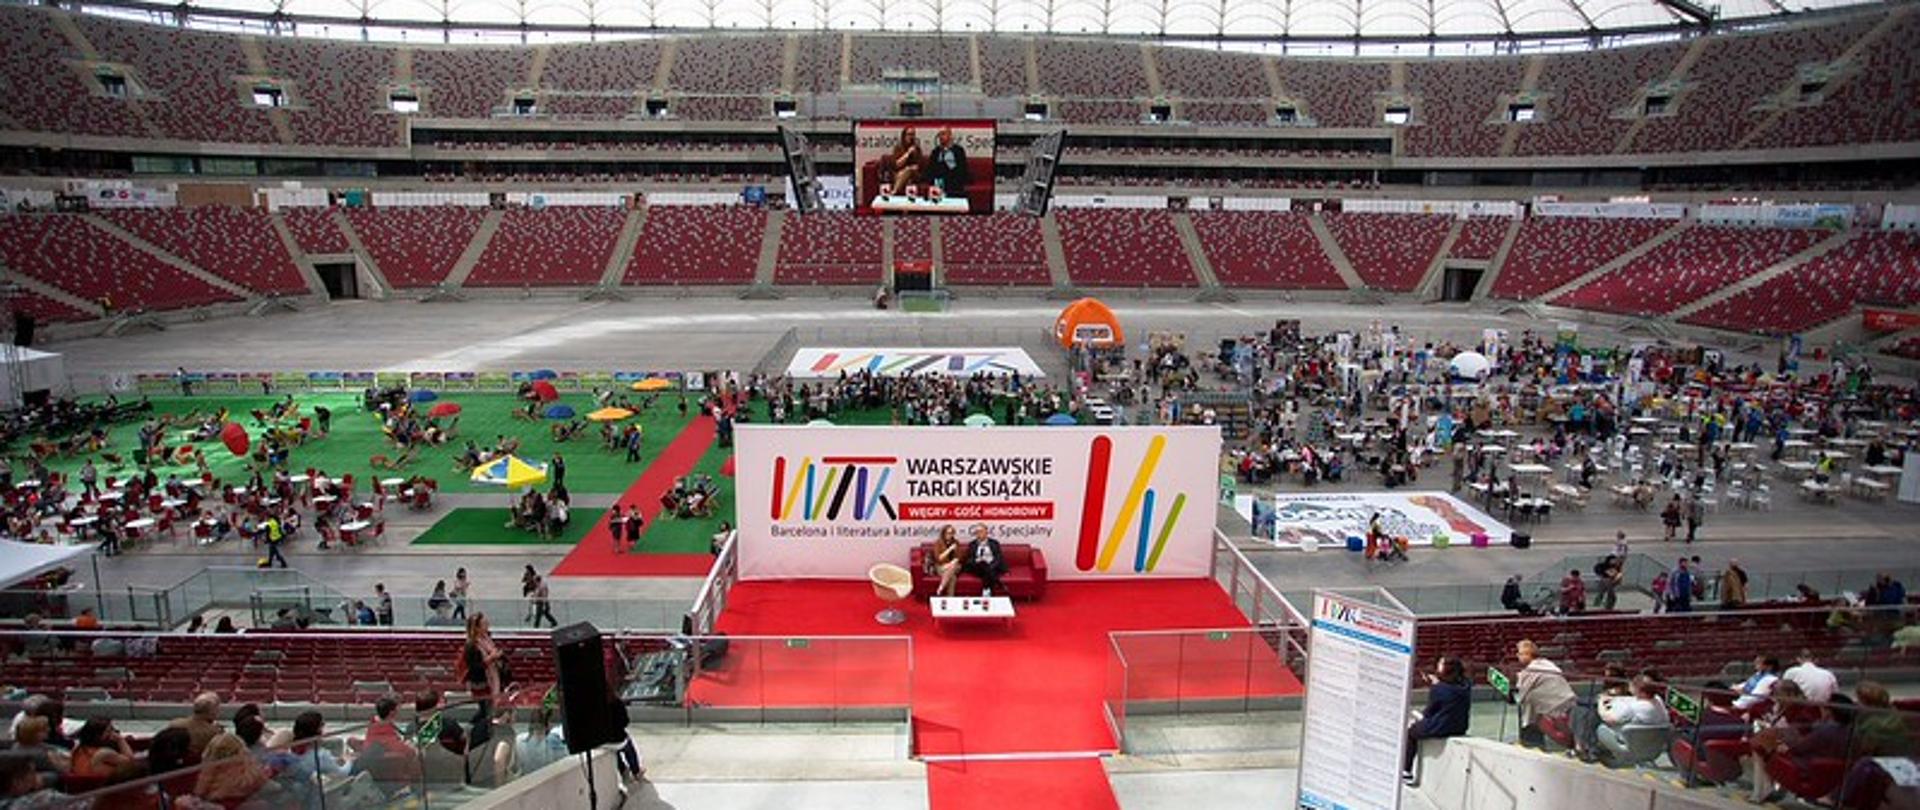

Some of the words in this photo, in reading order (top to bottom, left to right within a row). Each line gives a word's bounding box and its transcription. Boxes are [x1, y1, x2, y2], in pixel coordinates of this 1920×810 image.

[906, 458, 1052, 475] WARSZAWSKIE
[906, 480, 962, 496] TARGI
[967, 476, 1041, 500] KSIĄŻKI
[908, 507, 947, 518] WĘGRY
[983, 507, 1048, 517] HONOROWY
[771, 525, 827, 537] Barcelona
[837, 525, 890, 537] literatura
[999, 525, 1053, 540] Specjalny
